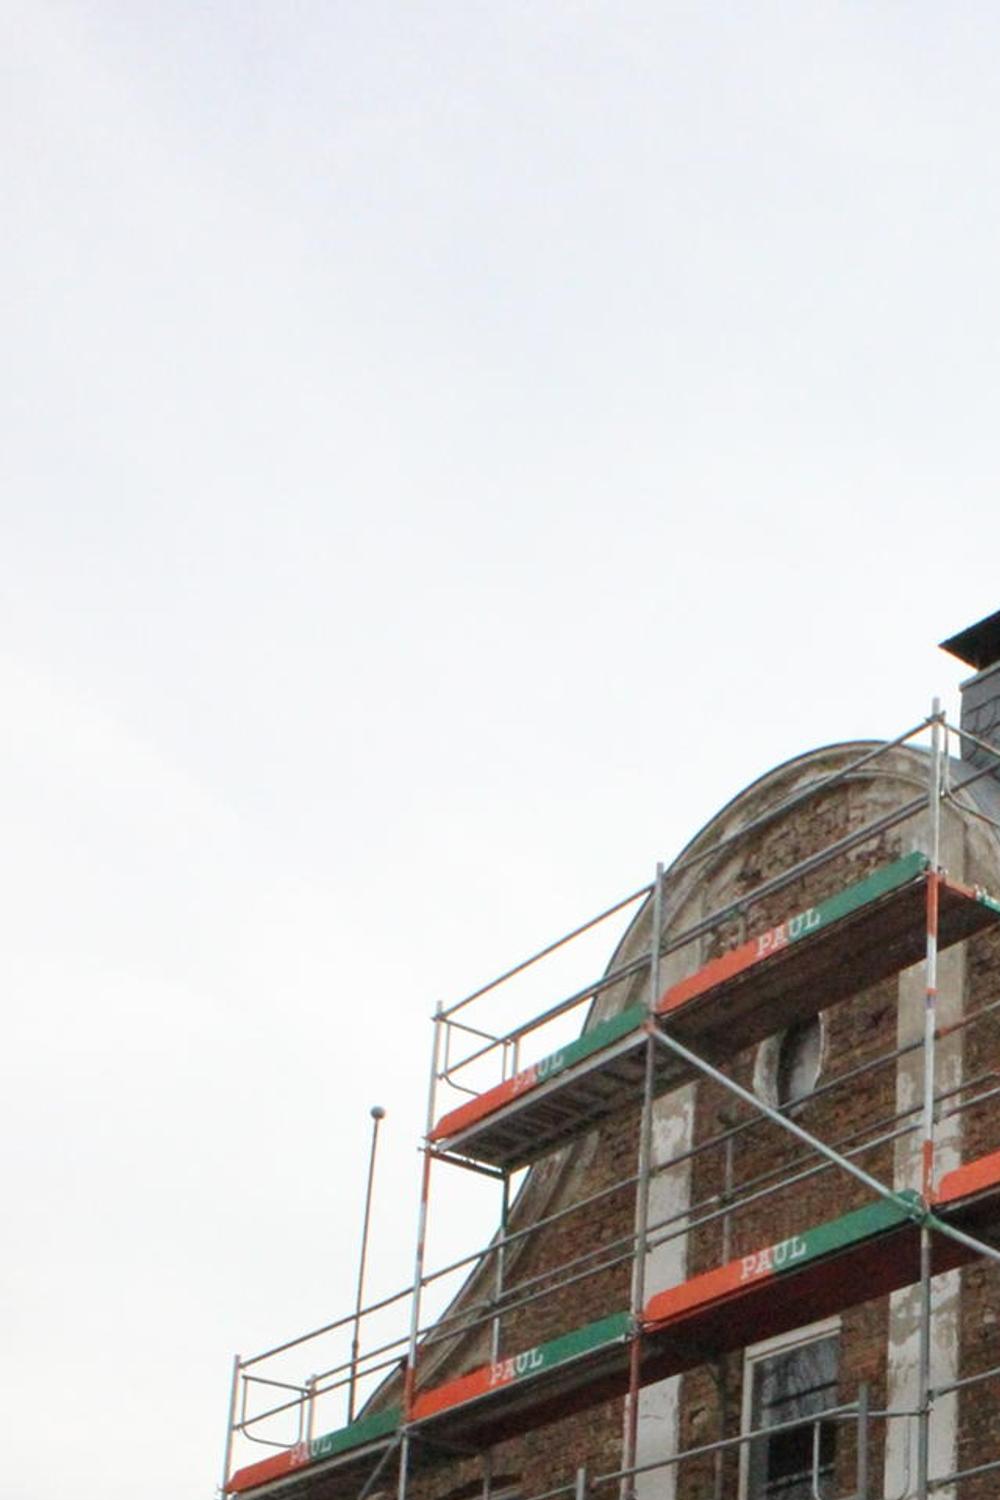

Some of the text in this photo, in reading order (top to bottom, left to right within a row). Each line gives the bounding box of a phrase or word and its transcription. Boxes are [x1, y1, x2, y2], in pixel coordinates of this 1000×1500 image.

[757, 907, 821, 955] PAUL
[741, 1236, 806, 1280] PAUL
[489, 1349, 543, 1386] PAUL
